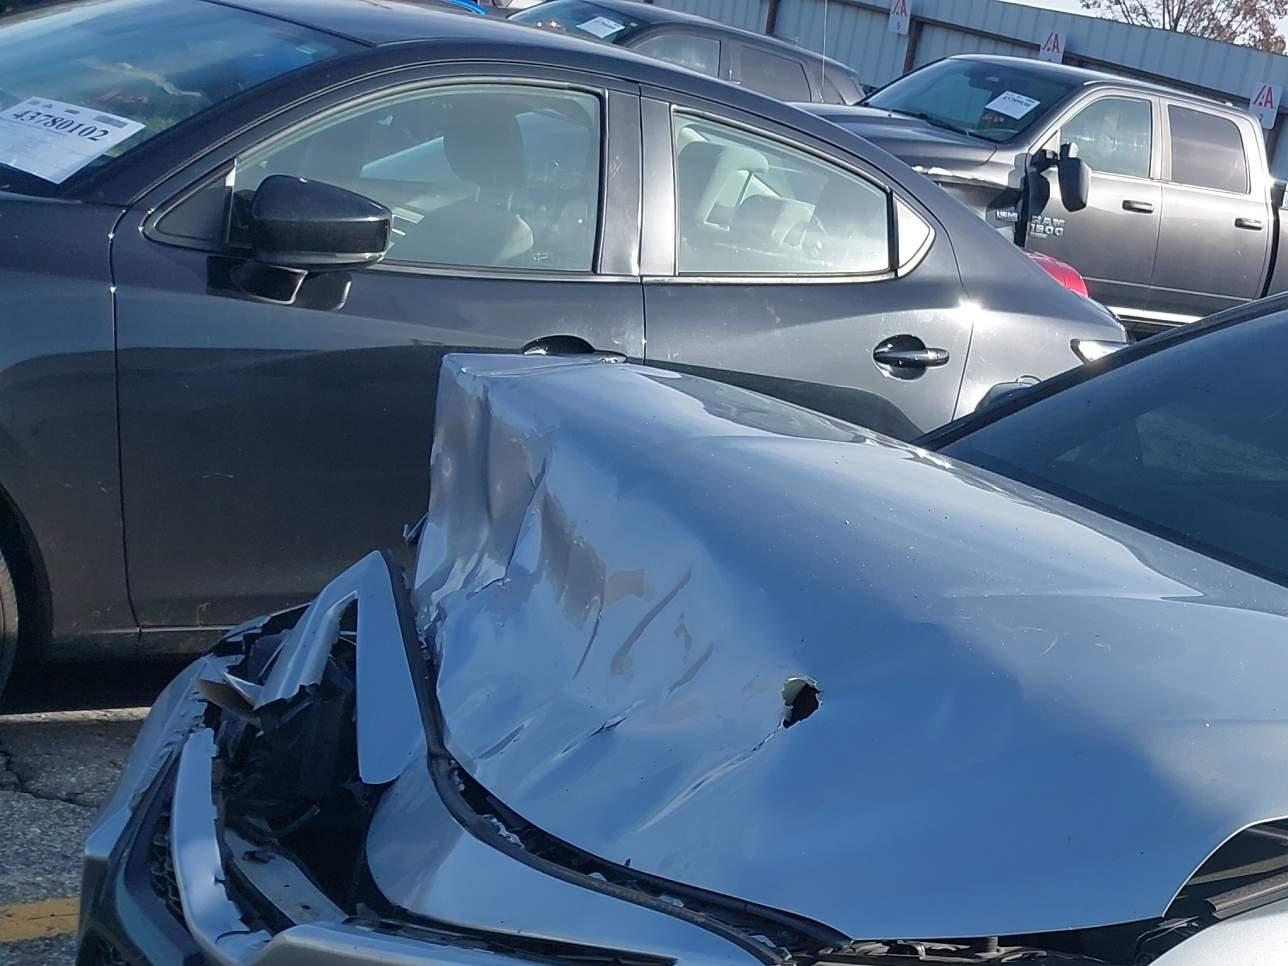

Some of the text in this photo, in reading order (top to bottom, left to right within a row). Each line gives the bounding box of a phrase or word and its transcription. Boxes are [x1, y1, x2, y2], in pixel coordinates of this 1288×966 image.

[13, 110, 109, 141] 43780102
[1032, 215, 1065, 227] RAM
[1030, 223, 1064, 237] 1500
